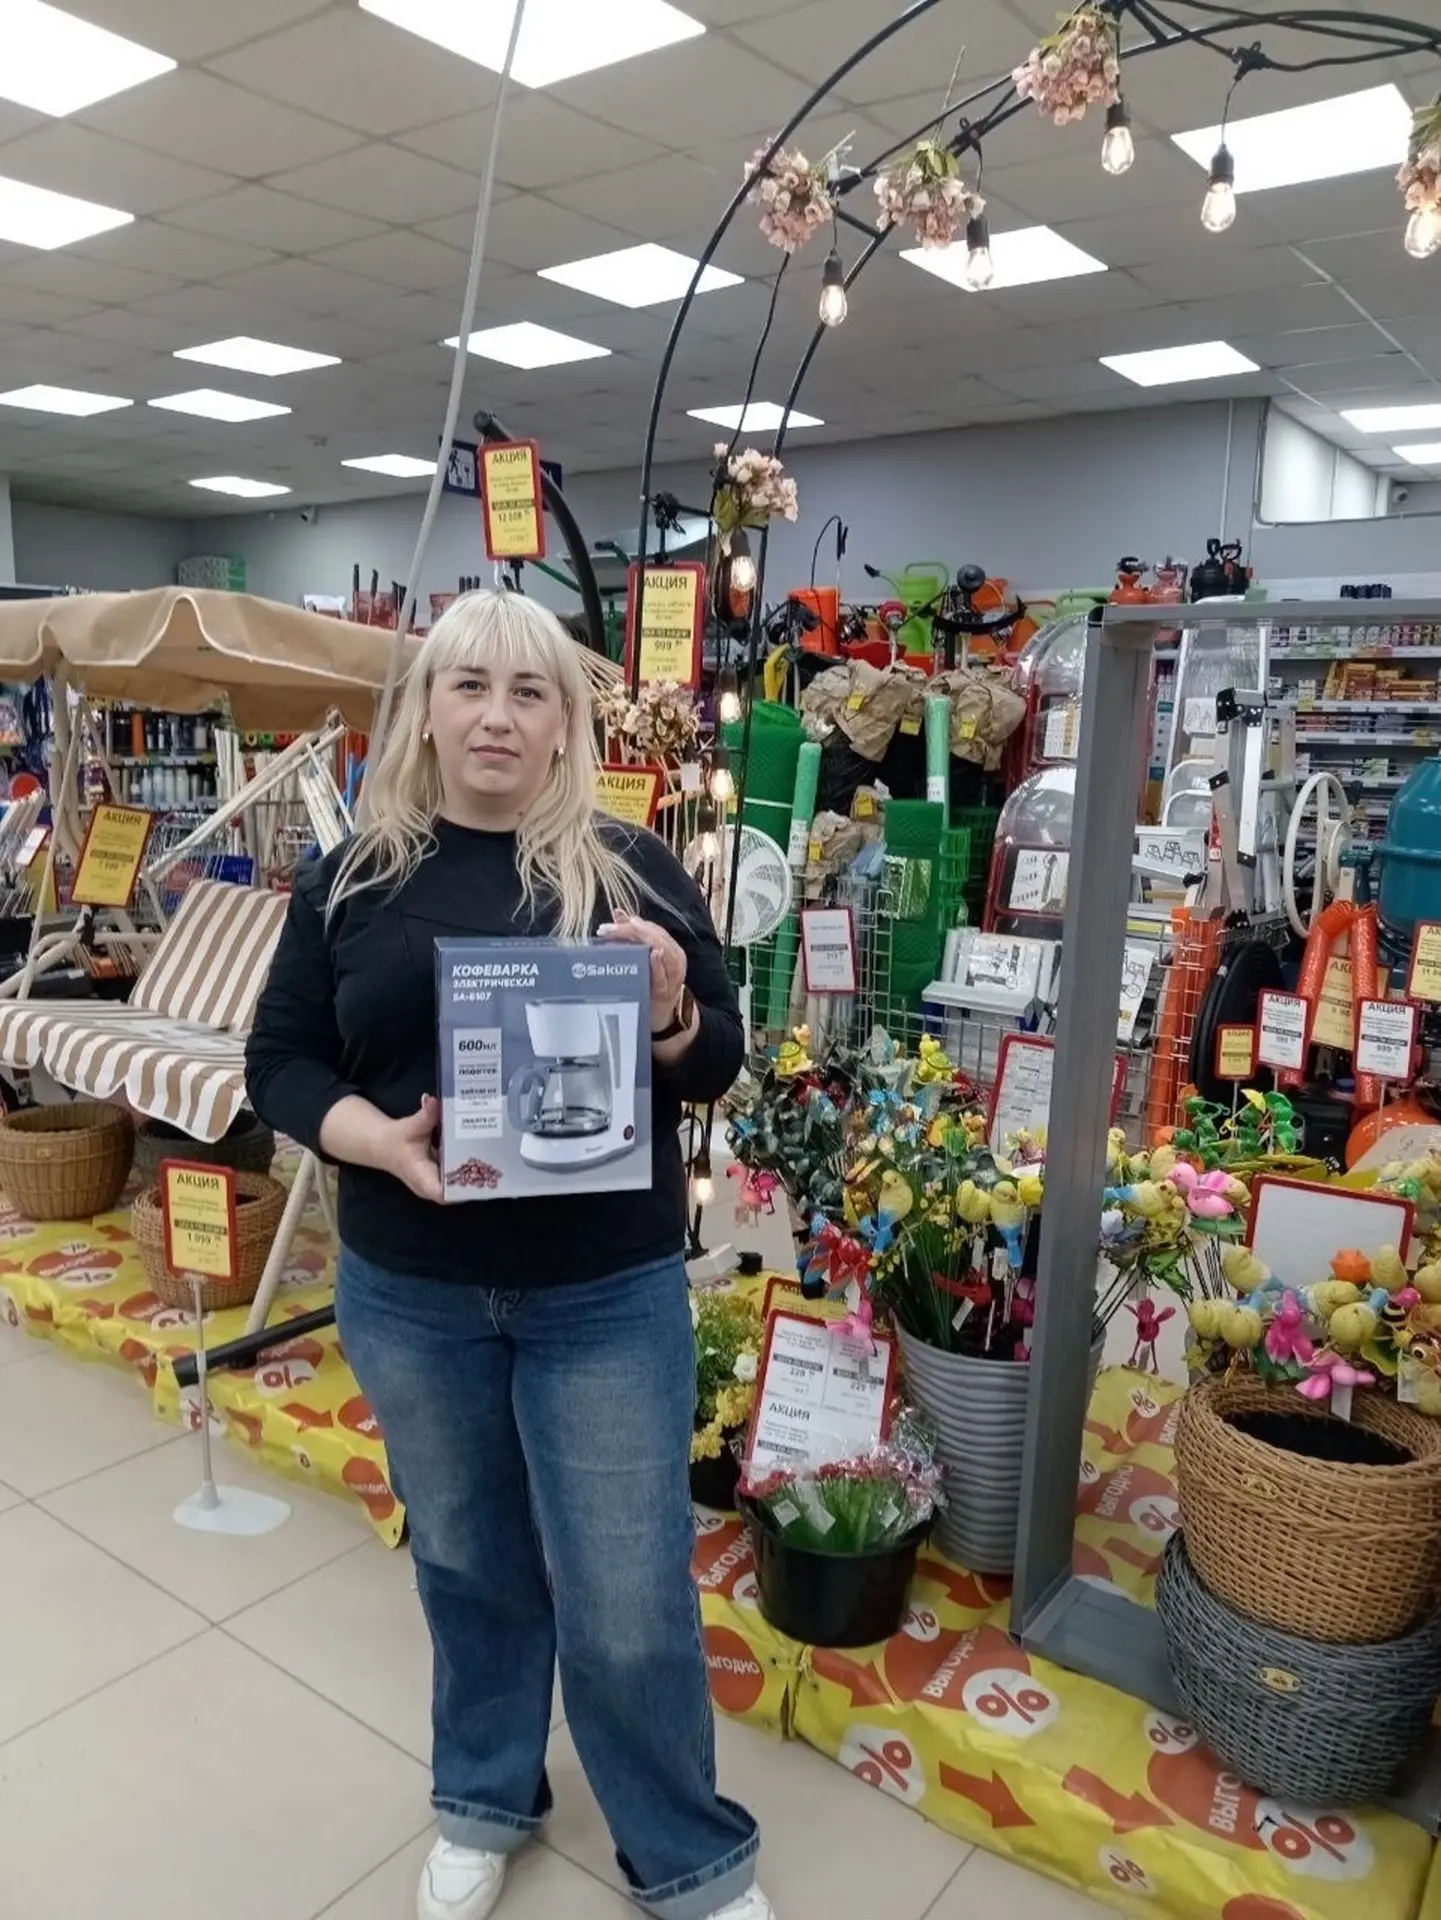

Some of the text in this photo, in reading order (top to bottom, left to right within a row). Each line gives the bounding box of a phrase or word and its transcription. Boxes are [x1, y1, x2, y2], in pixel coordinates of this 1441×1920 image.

[492, 450, 528, 465] АКЦИЯ
[645, 575, 688, 591] АКЦИЯ
[597, 775, 646, 791] АКЦИЯ
[452, 963, 540, 977] КОФЕВАРКА
[587, 963, 639, 977] Sakura
[452, 978, 536, 989] ЭЛЕКТРИЧЕСКАЯ
[1268, 994, 1301, 1008] АКЦИЯ
[1367, 1002, 1407, 1016] АКЦИЯ
[176, 1172, 220, 1190] АКЦИЯ
[768, 1401, 811, 1421] АКЦИЯ
[1208, 1772, 1244, 1834] ВЫГО
